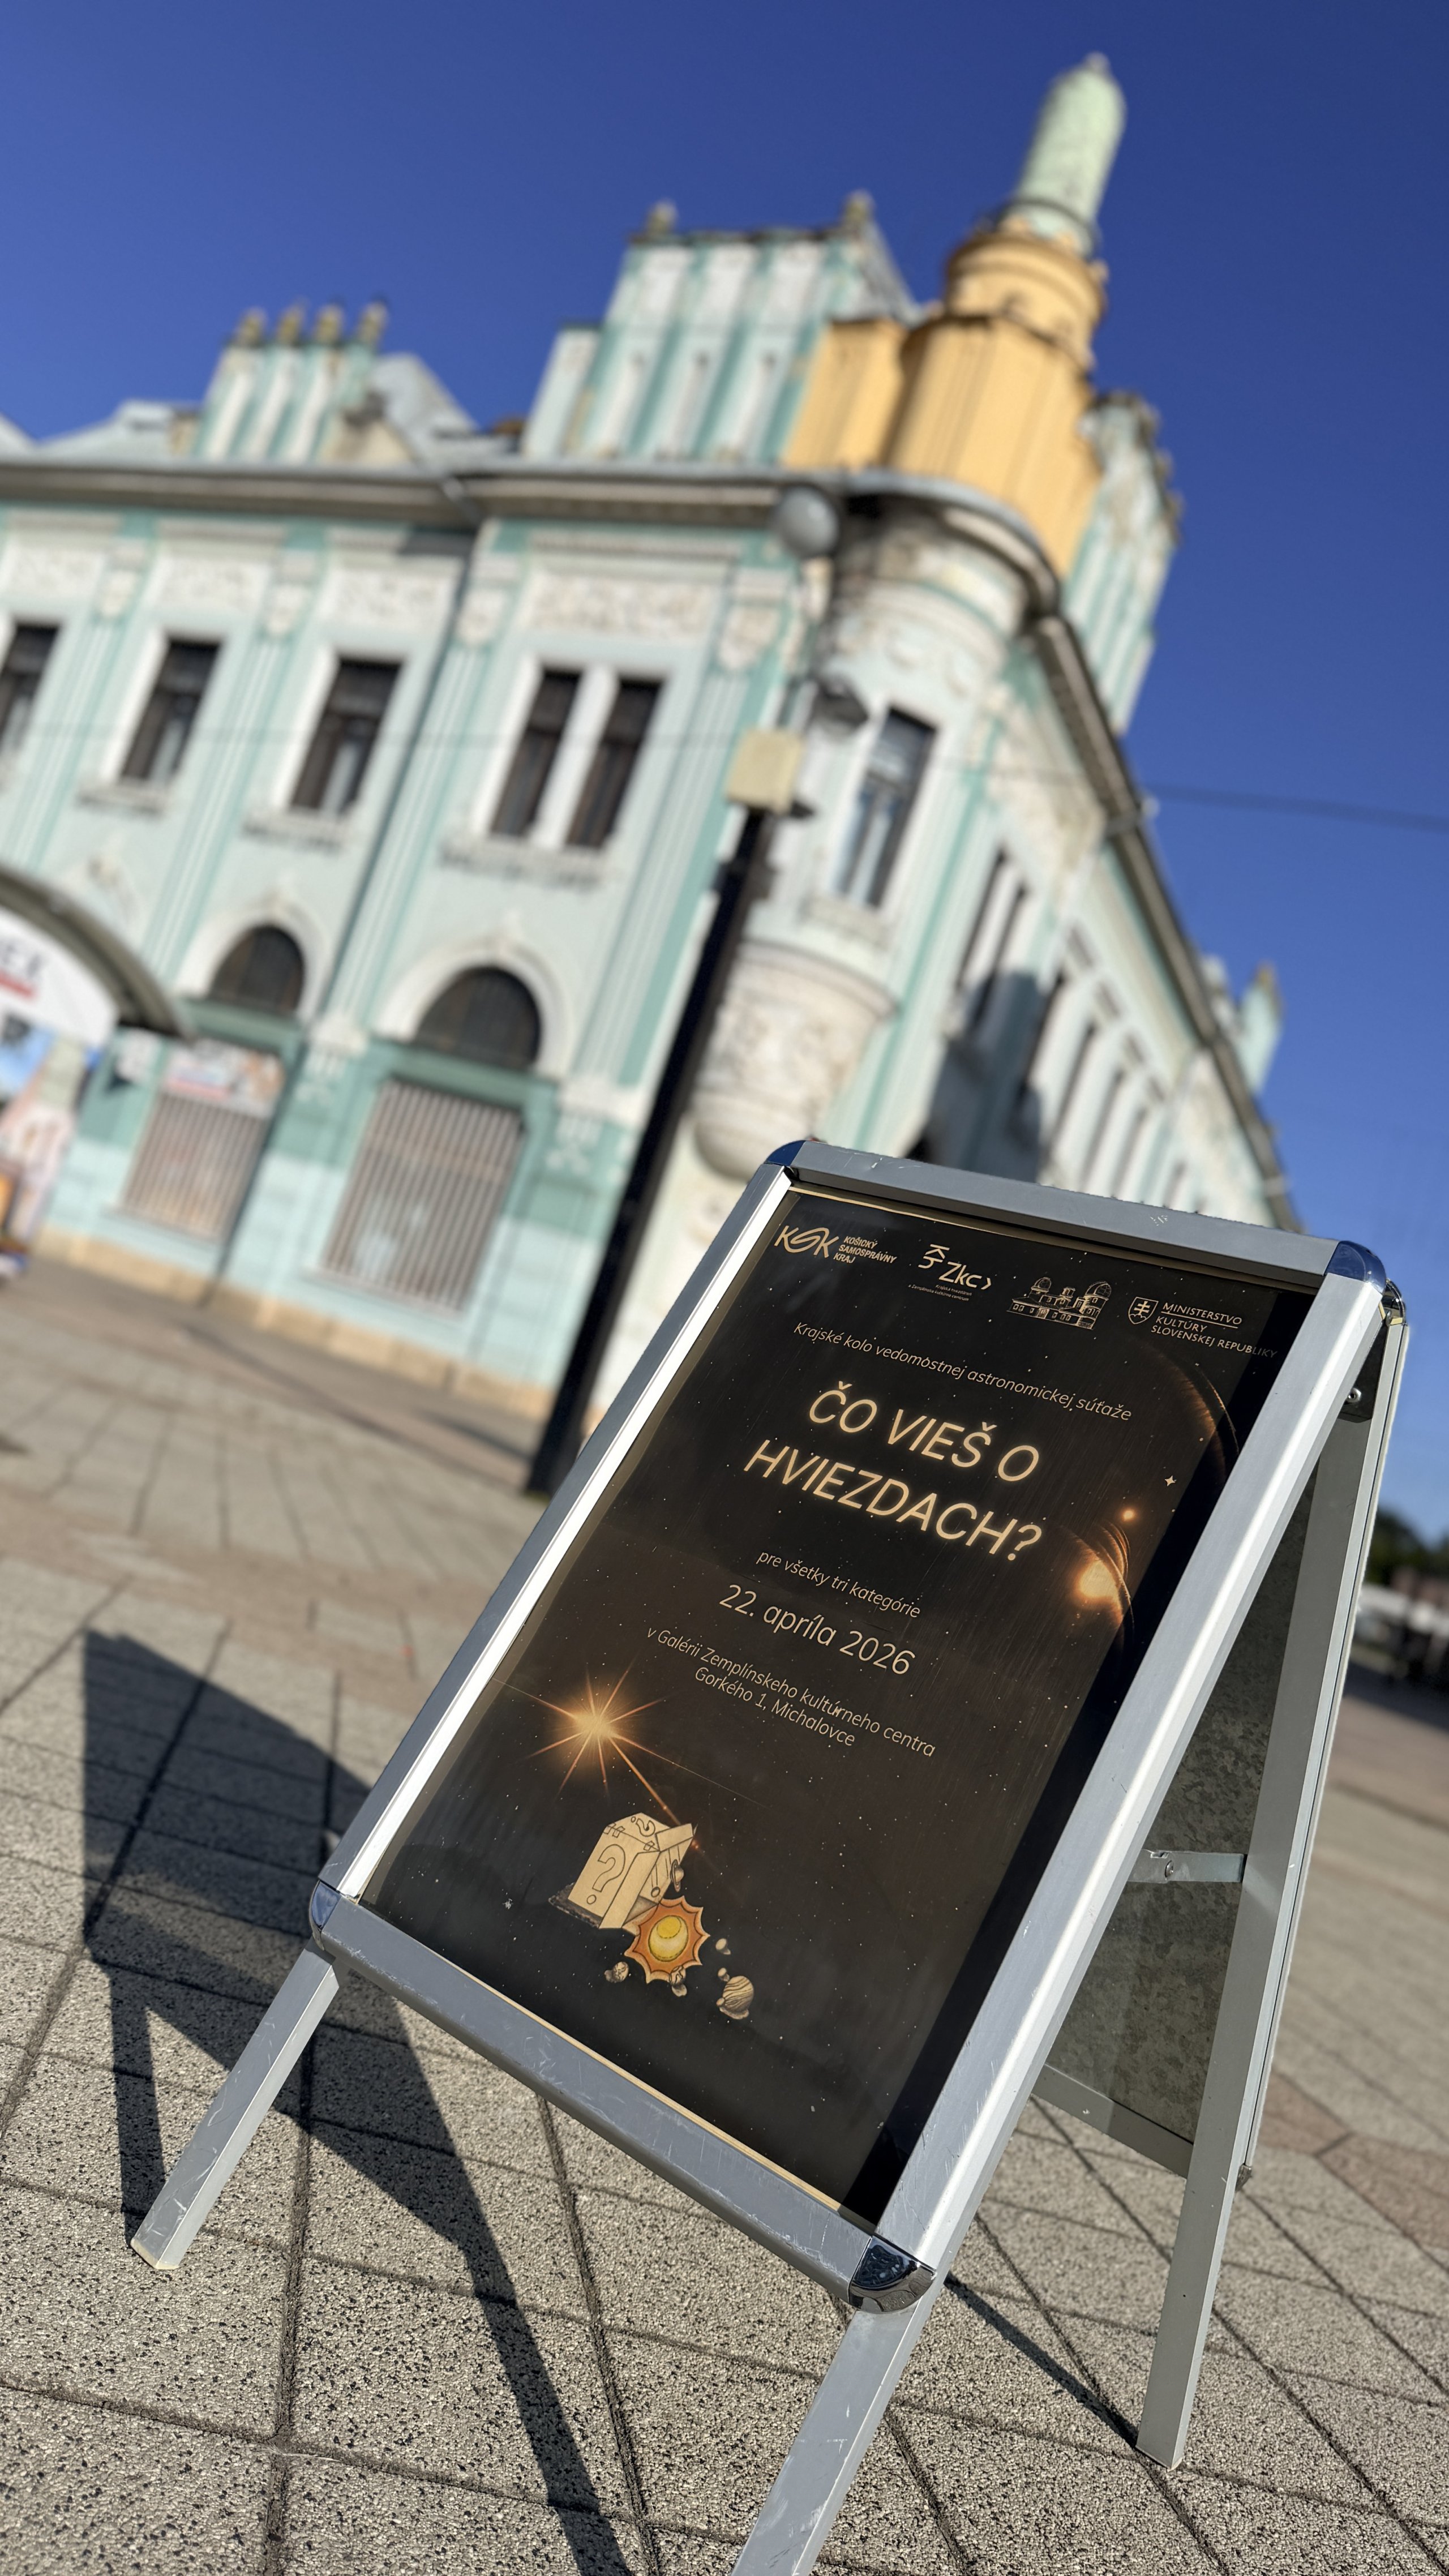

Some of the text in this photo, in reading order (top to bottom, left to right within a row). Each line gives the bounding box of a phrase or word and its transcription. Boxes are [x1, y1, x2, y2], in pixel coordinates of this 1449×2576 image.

[833, 1253, 856, 1263] KRAJ
[839, 1245, 897, 1263] SAMOSPRÁVNY
[843, 1236, 878, 1249] KOŠICKÝ
[1151, 1325, 1278, 1358] SLOVENSKEJ REPUBLIKY
[1155, 1316, 1207, 1332] KULTÚRY
[1163, 1302, 1242, 1325] MINISTERSTVO
[794, 1322, 1131, 1420] Krajské kolo vedomostnej astronomickej súťaže
[809, 1381, 1040, 1481] ČO VIEŠ O
[743, 1439, 1042, 1561] HVIEZDACH?
[756, 1551, 920, 1618] pre všetky tri kategórie
[719, 1584, 916, 1674] 22. apríla 2026
[647, 1628, 936, 1756] v Galérii Zemplínskeho kultúrneho centra
[695, 1667, 855, 1746] Gorkého 1, Michalovce
